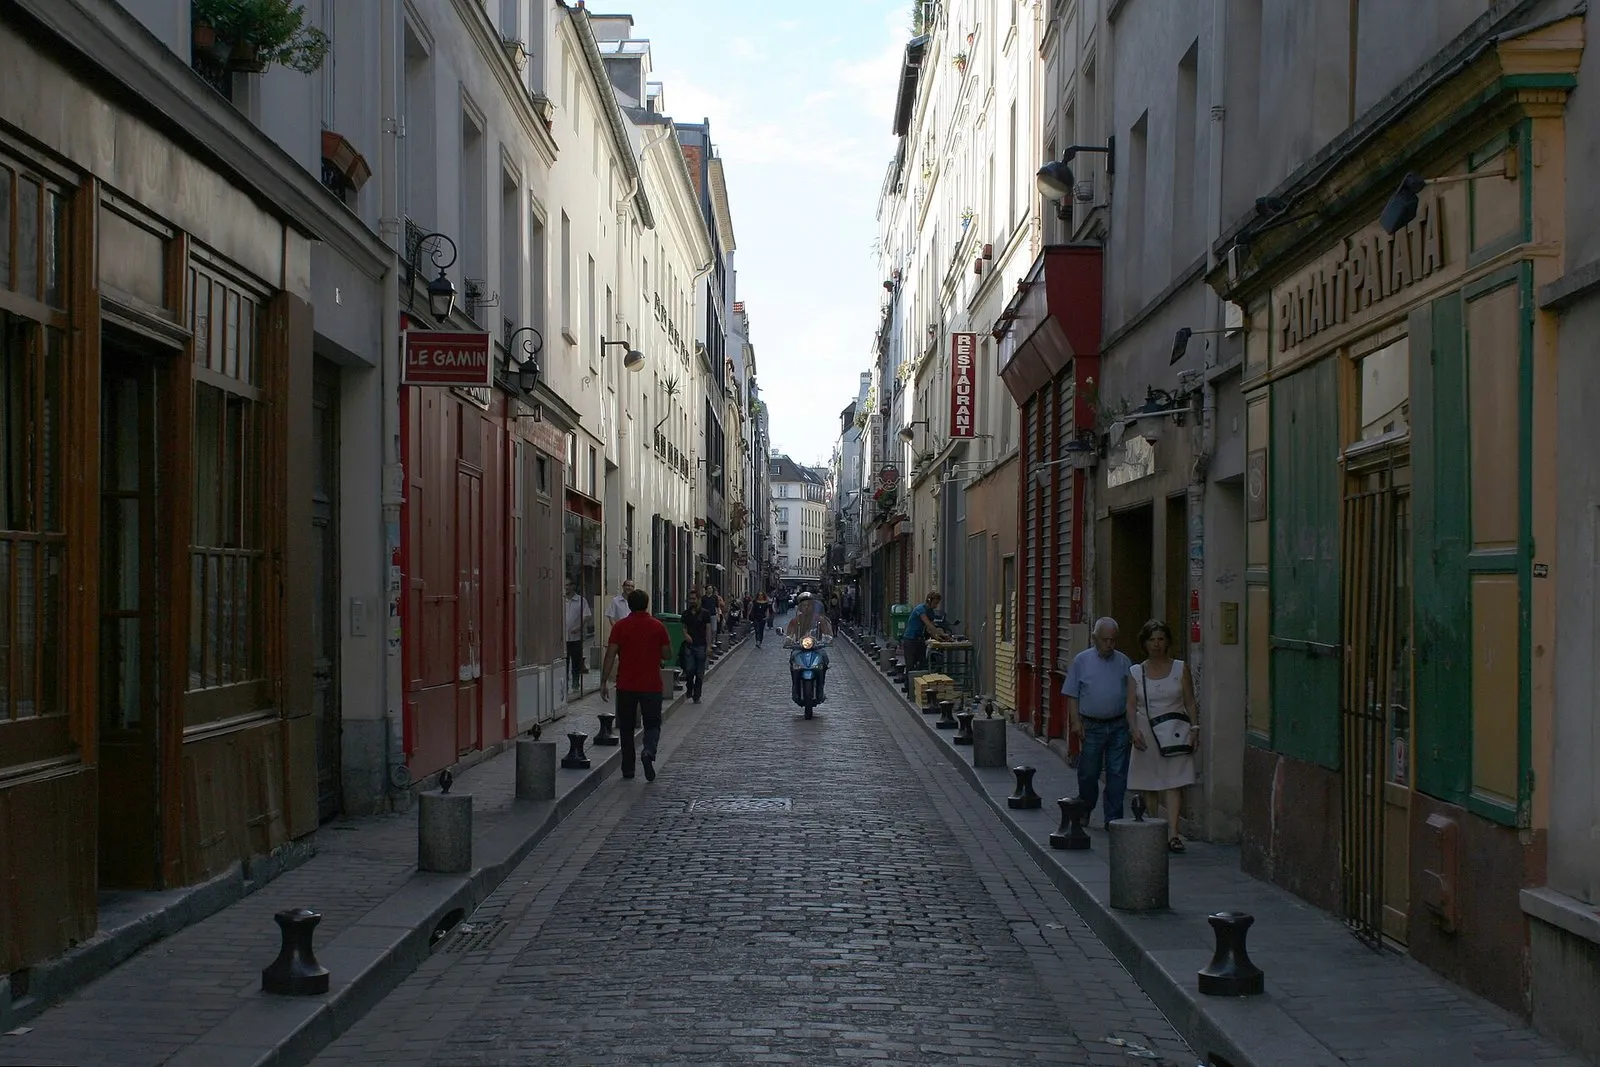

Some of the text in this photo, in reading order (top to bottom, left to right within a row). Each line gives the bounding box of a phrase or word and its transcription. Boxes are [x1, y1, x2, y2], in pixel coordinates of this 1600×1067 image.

[409, 349, 487, 368] LE GAMIN
[956, 335, 971, 436] RESTAURANT
